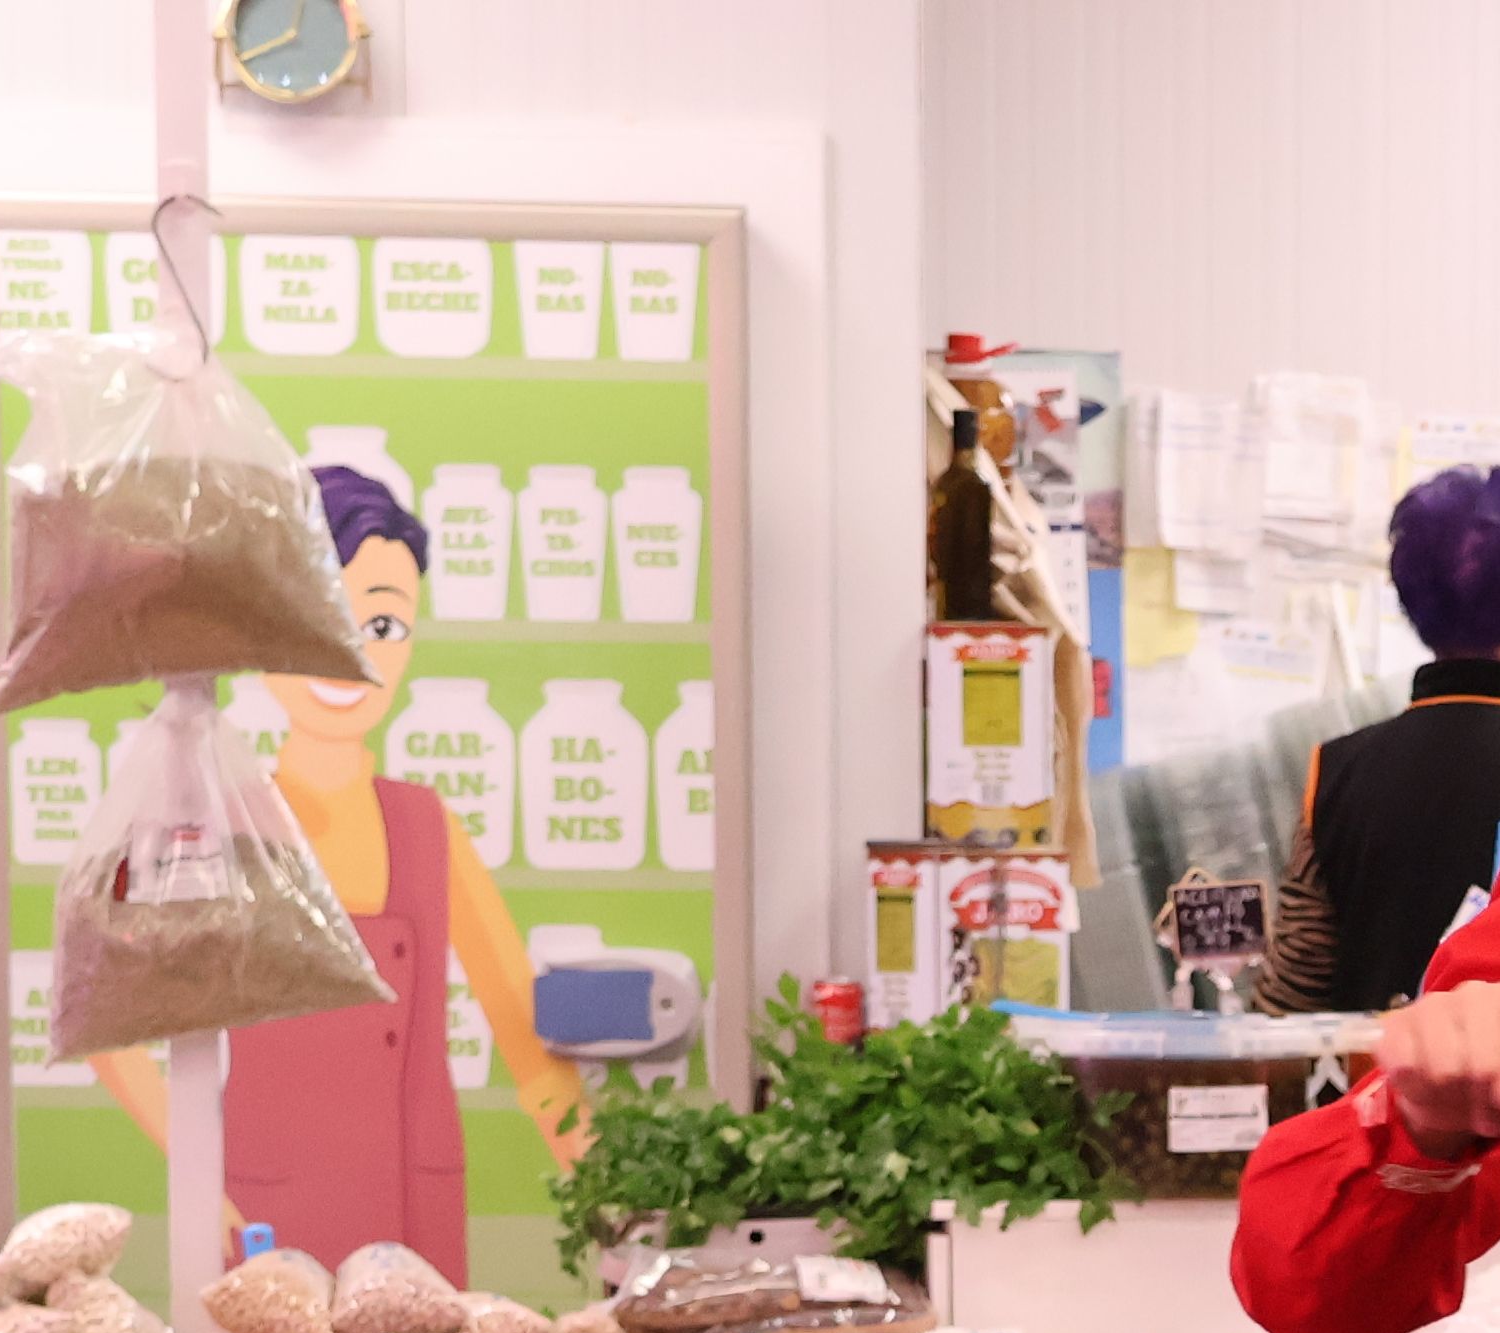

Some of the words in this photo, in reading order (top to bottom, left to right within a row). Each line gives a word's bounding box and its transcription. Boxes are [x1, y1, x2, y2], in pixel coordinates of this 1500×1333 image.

[385, 291, 480, 313] BECHE
[404, 732, 496, 758] GAR-
[550, 737, 616, 763] HA-
[553, 776, 616, 803] BO-
[546, 816, 624, 843] NES
